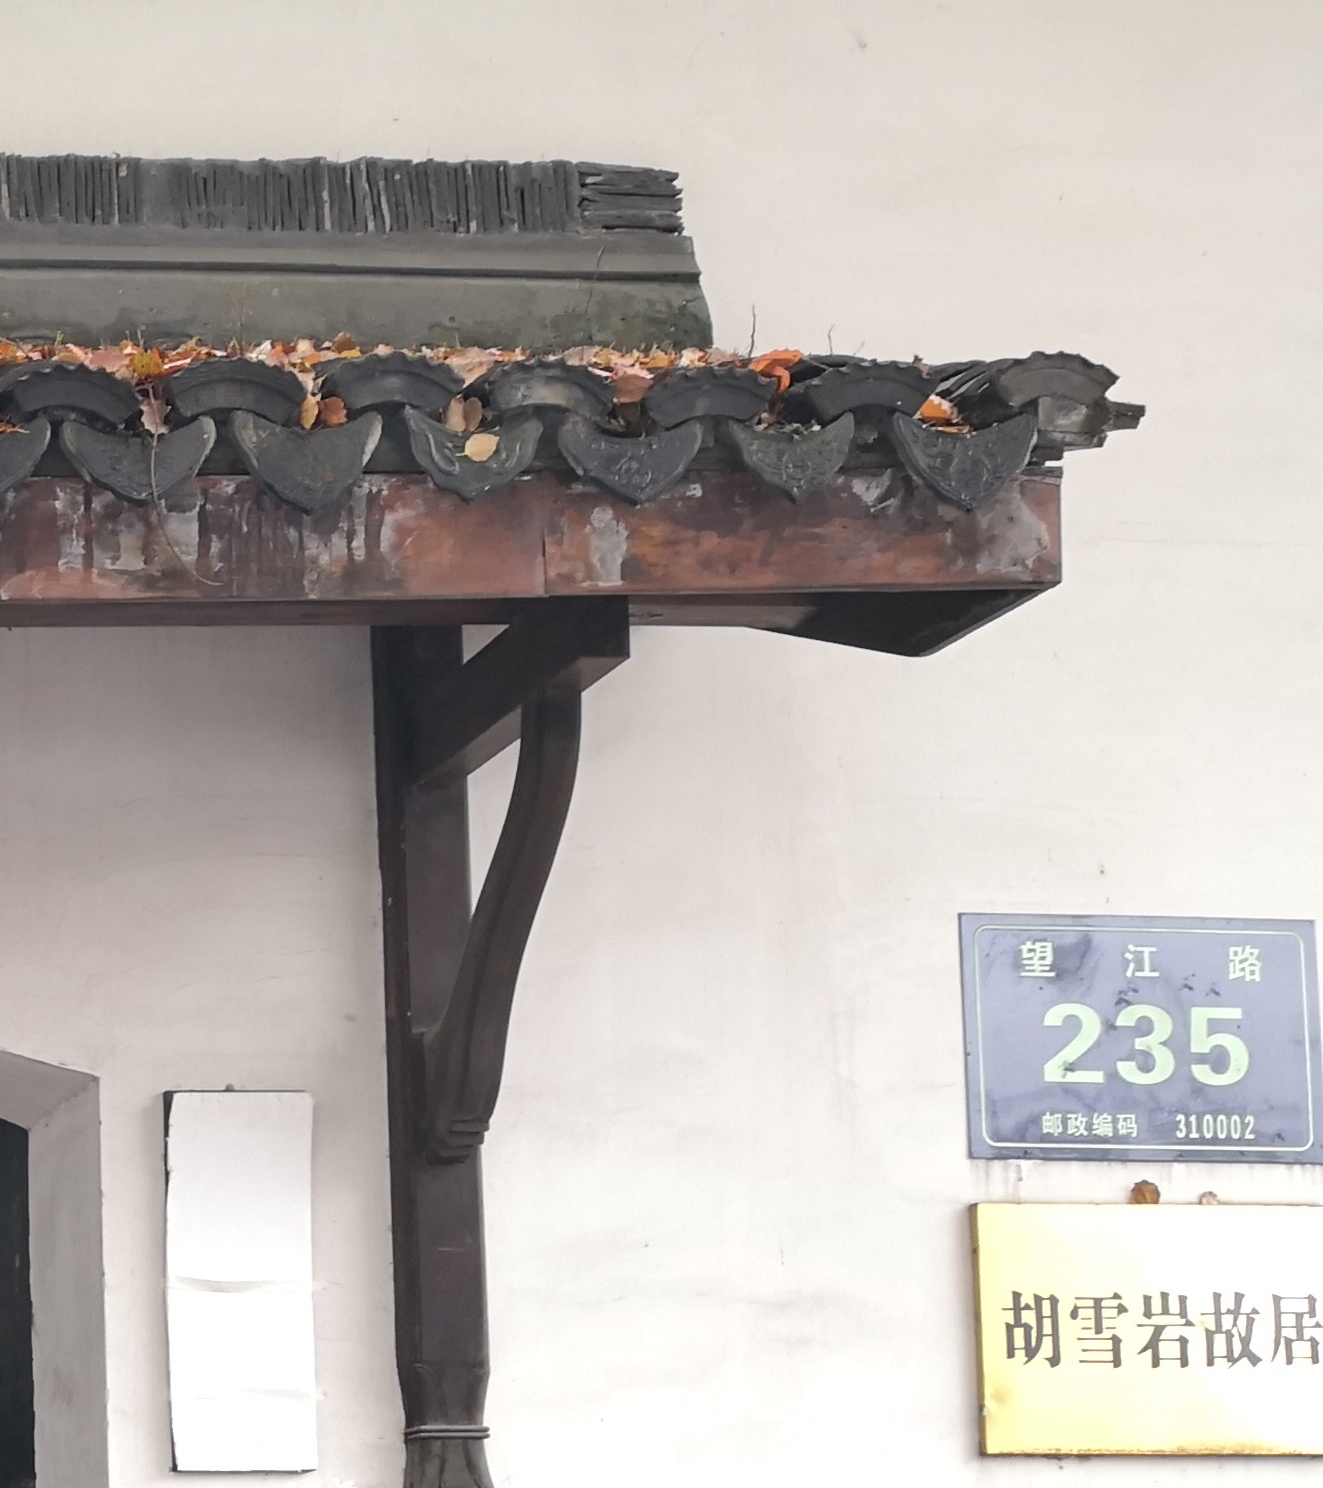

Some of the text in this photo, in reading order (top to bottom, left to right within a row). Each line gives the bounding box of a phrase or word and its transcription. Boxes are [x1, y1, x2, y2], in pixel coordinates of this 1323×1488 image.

[1019, 940, 1264, 983] 望江路
[1042, 1002, 1251, 1086] 235
[1041, 1111, 1256, 1141] 邮政编码 310002
[1001, 1290, 1323, 1370] 胡雪岩故居
